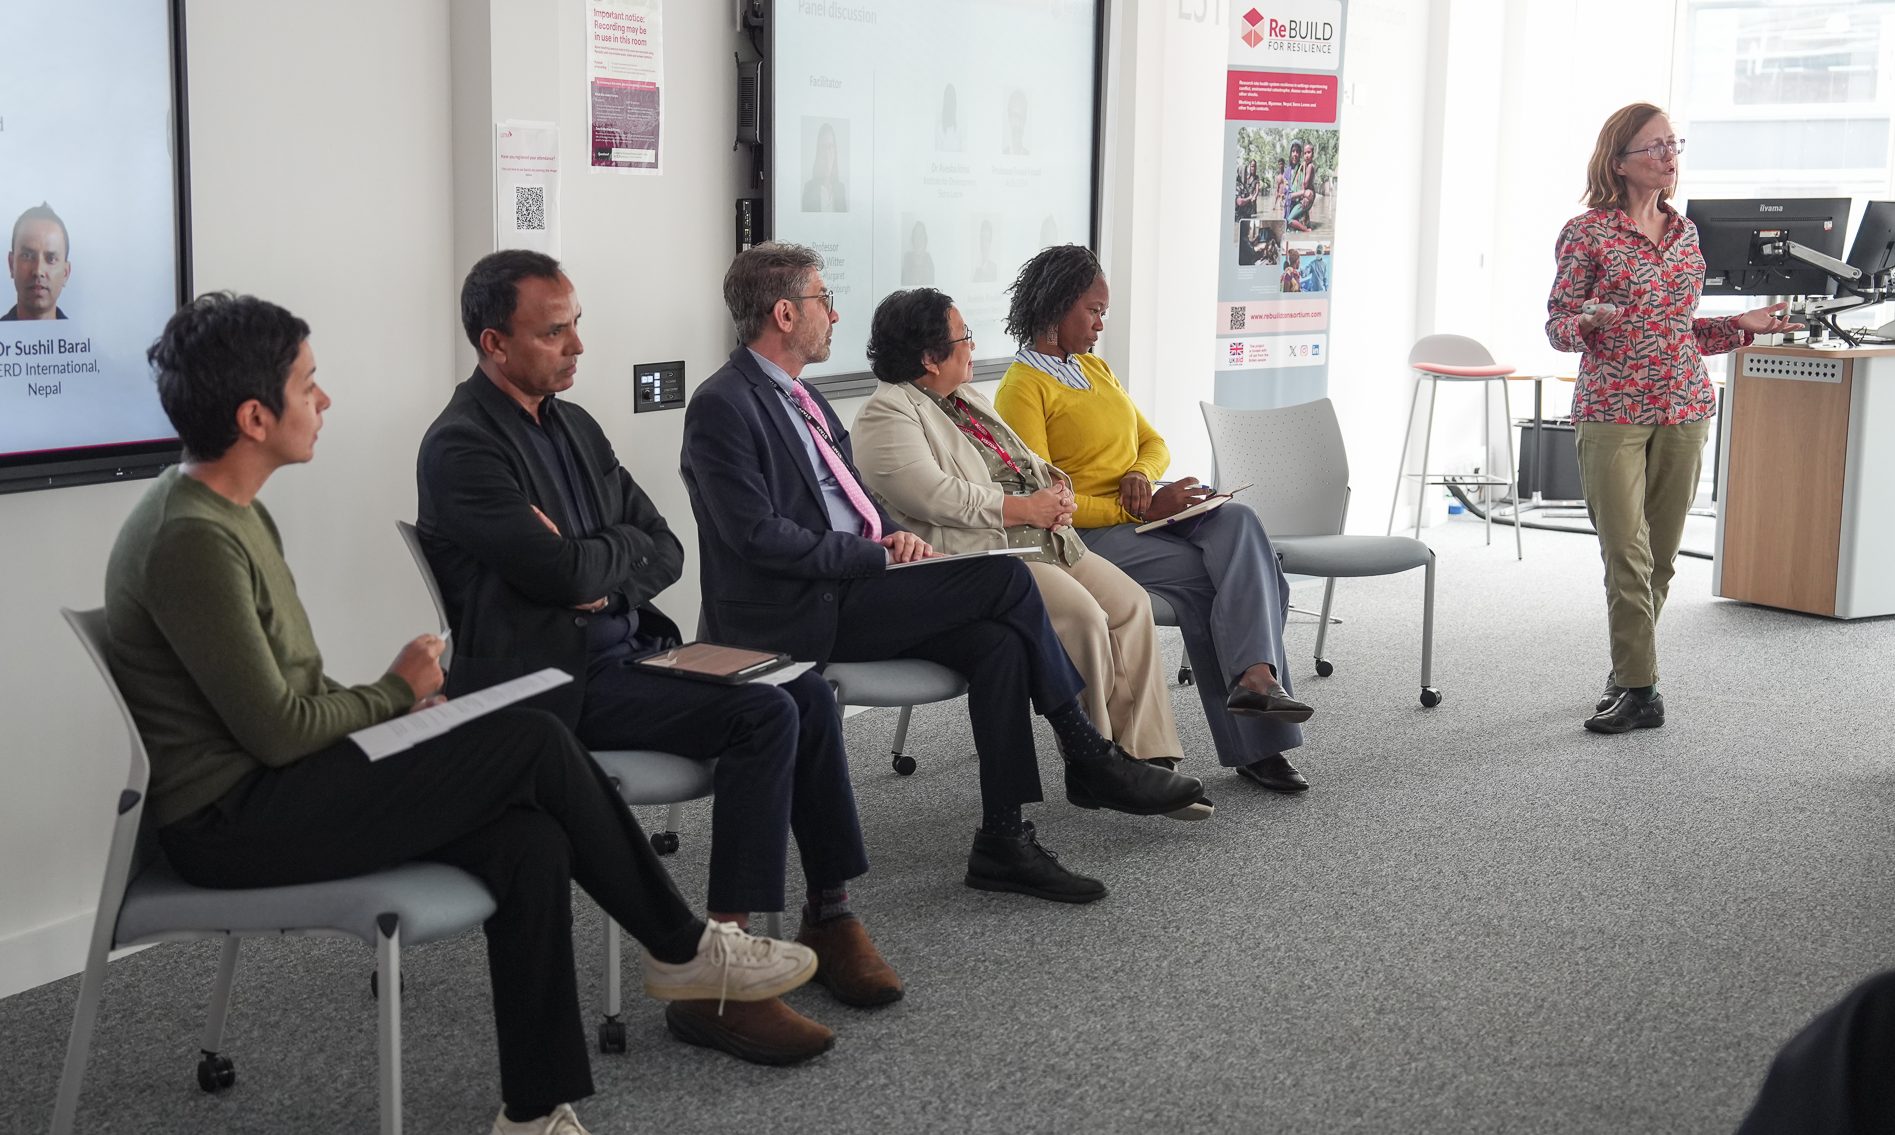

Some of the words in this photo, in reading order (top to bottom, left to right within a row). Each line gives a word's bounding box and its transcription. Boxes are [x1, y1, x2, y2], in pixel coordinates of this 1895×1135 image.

[594, 8, 624, 20] Important
[798, 0, 826, 17] Panel
[828, 2, 877, 24] discussion
[594, 20, 625, 34] Recording
[626, 26, 638, 35] may
[640, 26, 646, 34] be
[594, 32, 600, 40] in
[612, 34, 618, 43] in
[620, 36, 630, 45] this
[1268, 42, 1284, 50] FOR
[1287, 42, 1332, 54] RESILIENCE
[809, 75, 842, 88] Facilitator
[15, 339, 54, 356] Sushil
[58, 338, 91, 354] Baral
[26, 359, 100, 376] International,
[28, 381, 62, 398] Nepal
